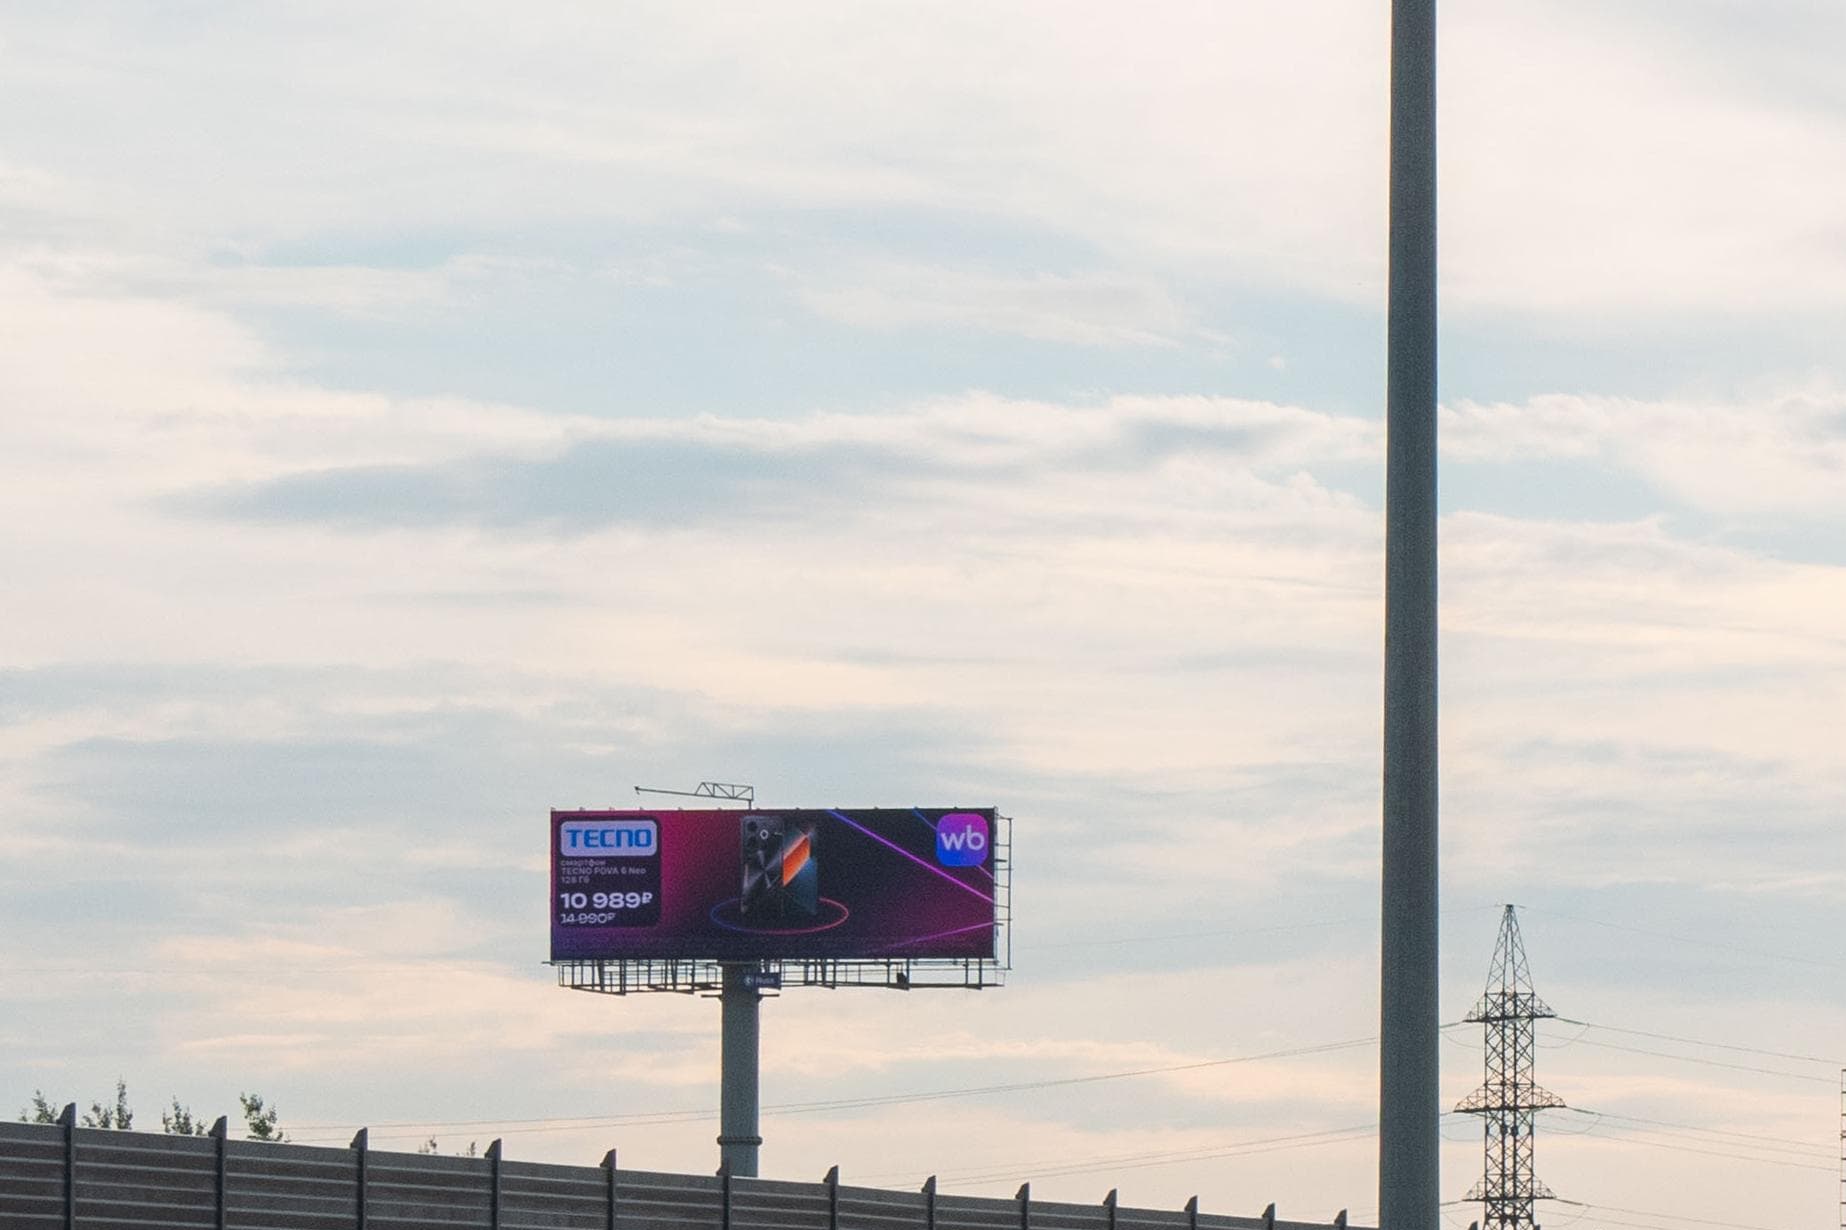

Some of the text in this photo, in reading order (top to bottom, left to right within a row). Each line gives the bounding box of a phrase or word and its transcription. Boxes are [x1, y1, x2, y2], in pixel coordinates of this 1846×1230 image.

[565, 828, 652, 848] TECNO
[941, 824, 985, 851] wb
[561, 867, 592, 875] TECNO
[560, 892, 587, 909] 10
